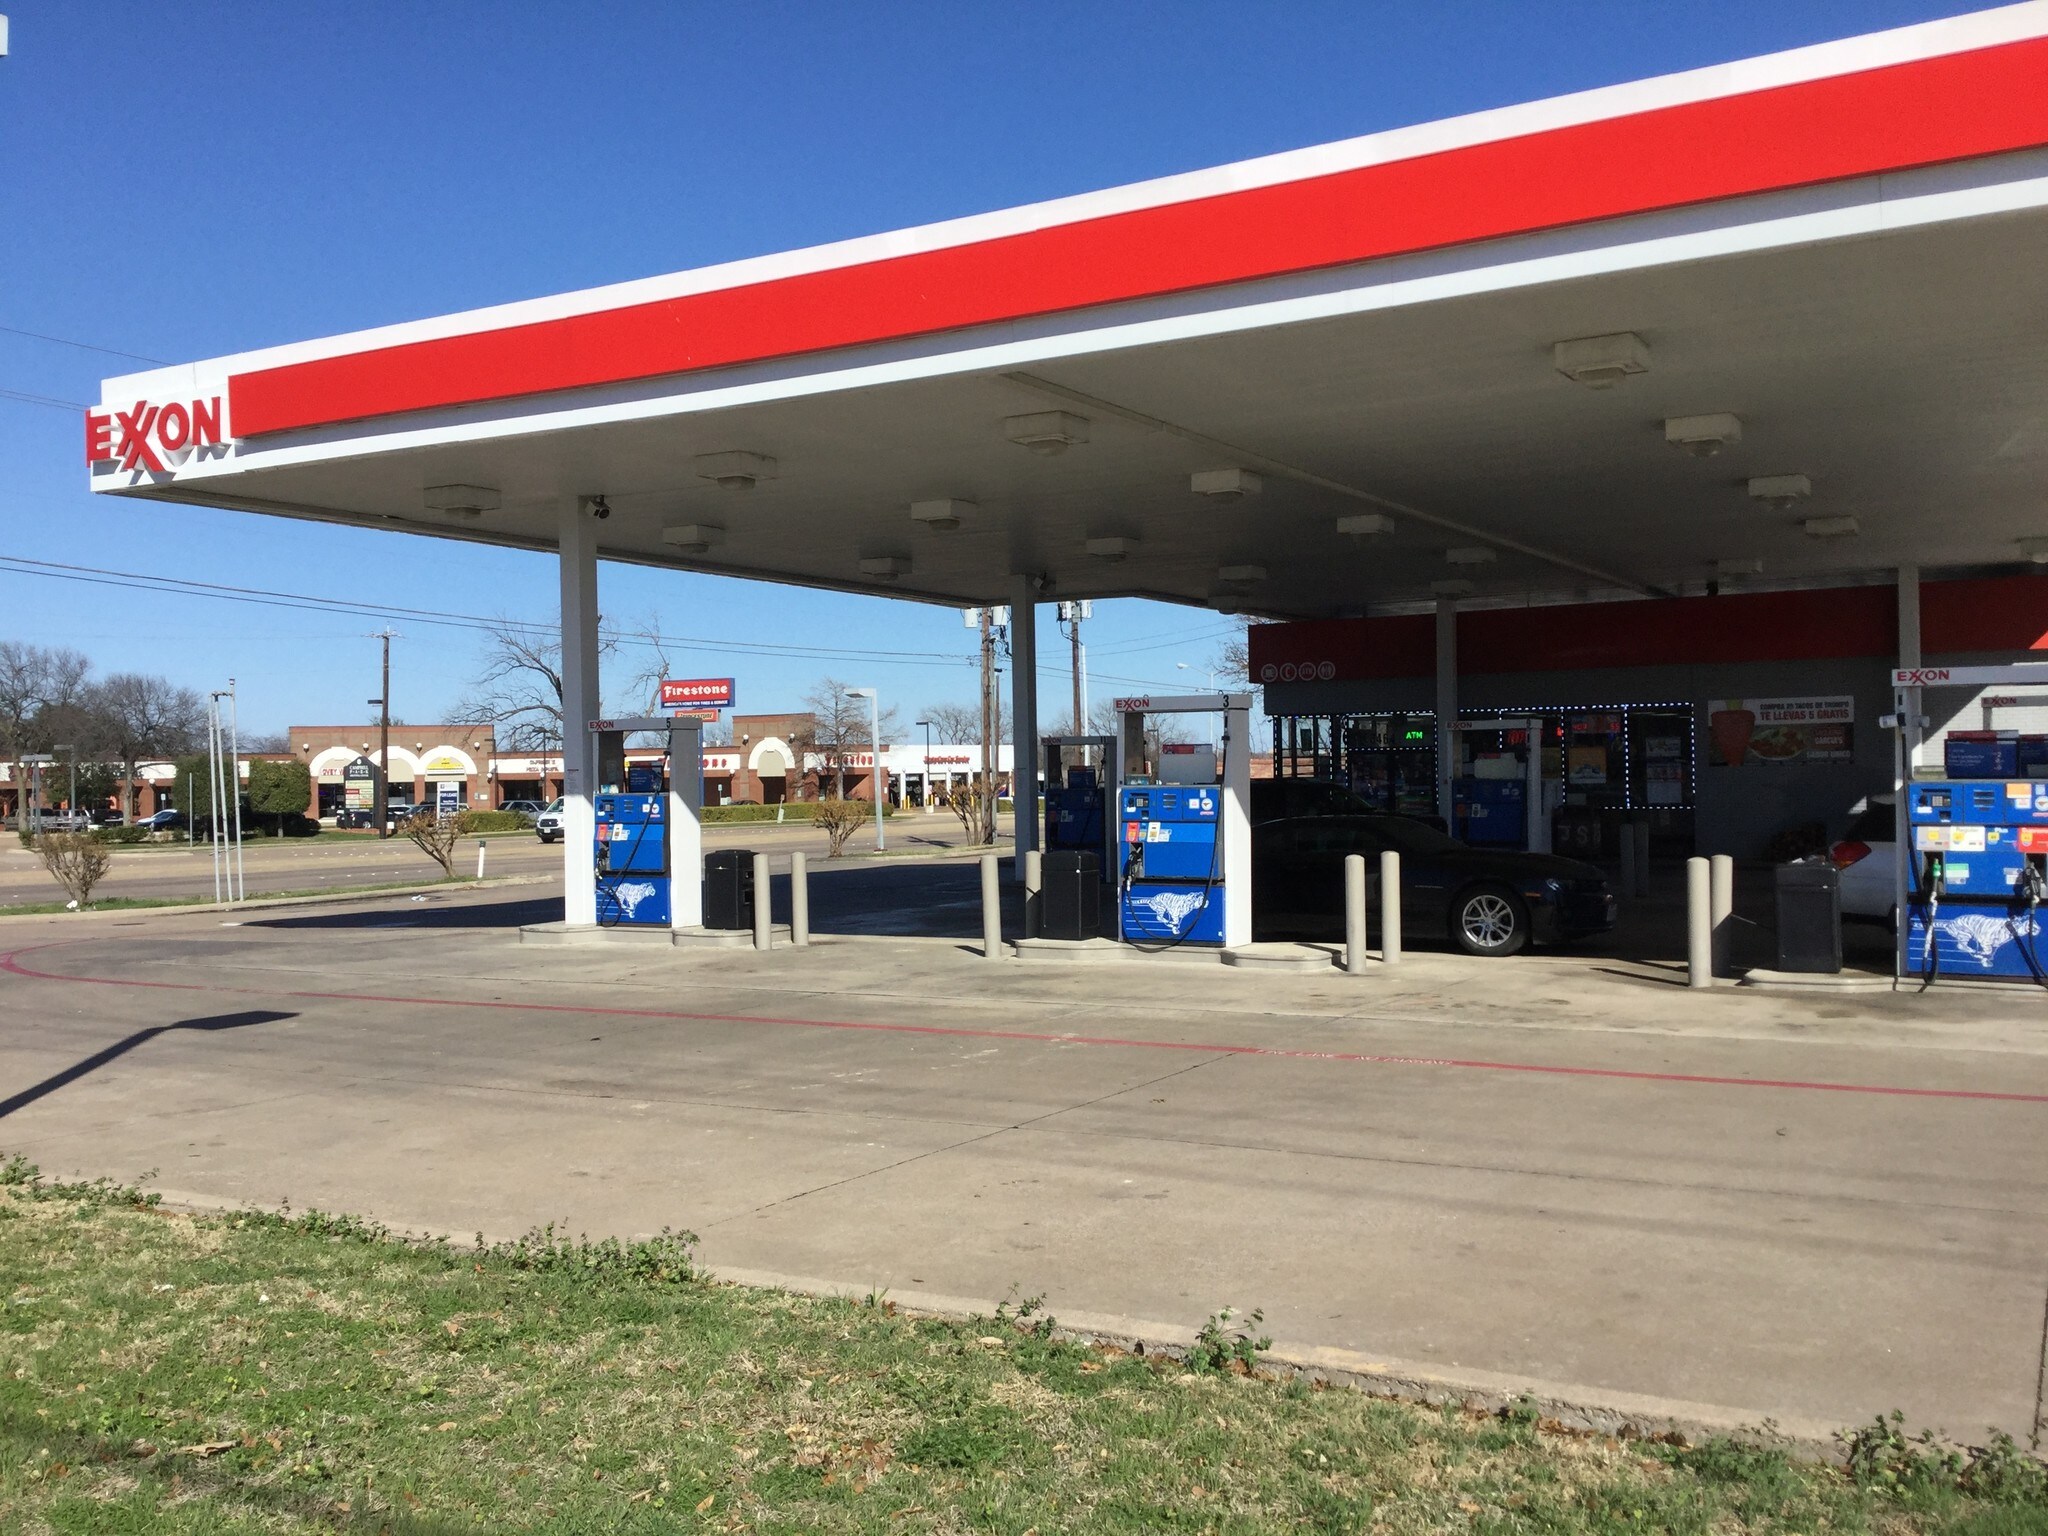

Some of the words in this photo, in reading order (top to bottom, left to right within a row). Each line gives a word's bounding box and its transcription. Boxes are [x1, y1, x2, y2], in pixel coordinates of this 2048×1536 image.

[86, 396, 221, 473] EXXON
[1896, 669, 1950, 685] EXXON
[664, 685, 728, 698] Firestone
[1116, 697, 1150, 711] EXXON
[1223, 695, 1230, 708] 3
[1984, 694, 2017, 707] EXXON
[1760, 711, 1771, 721] TE
[1773, 710, 1806, 721] LLEVAS
[1816, 708, 1850, 719] GRATIS
[590, 720, 614, 731] EXXON
[666, 717, 671, 729] 5
[1446, 720, 1472, 731] EXXON
[1405, 730, 1424, 740] ATM
